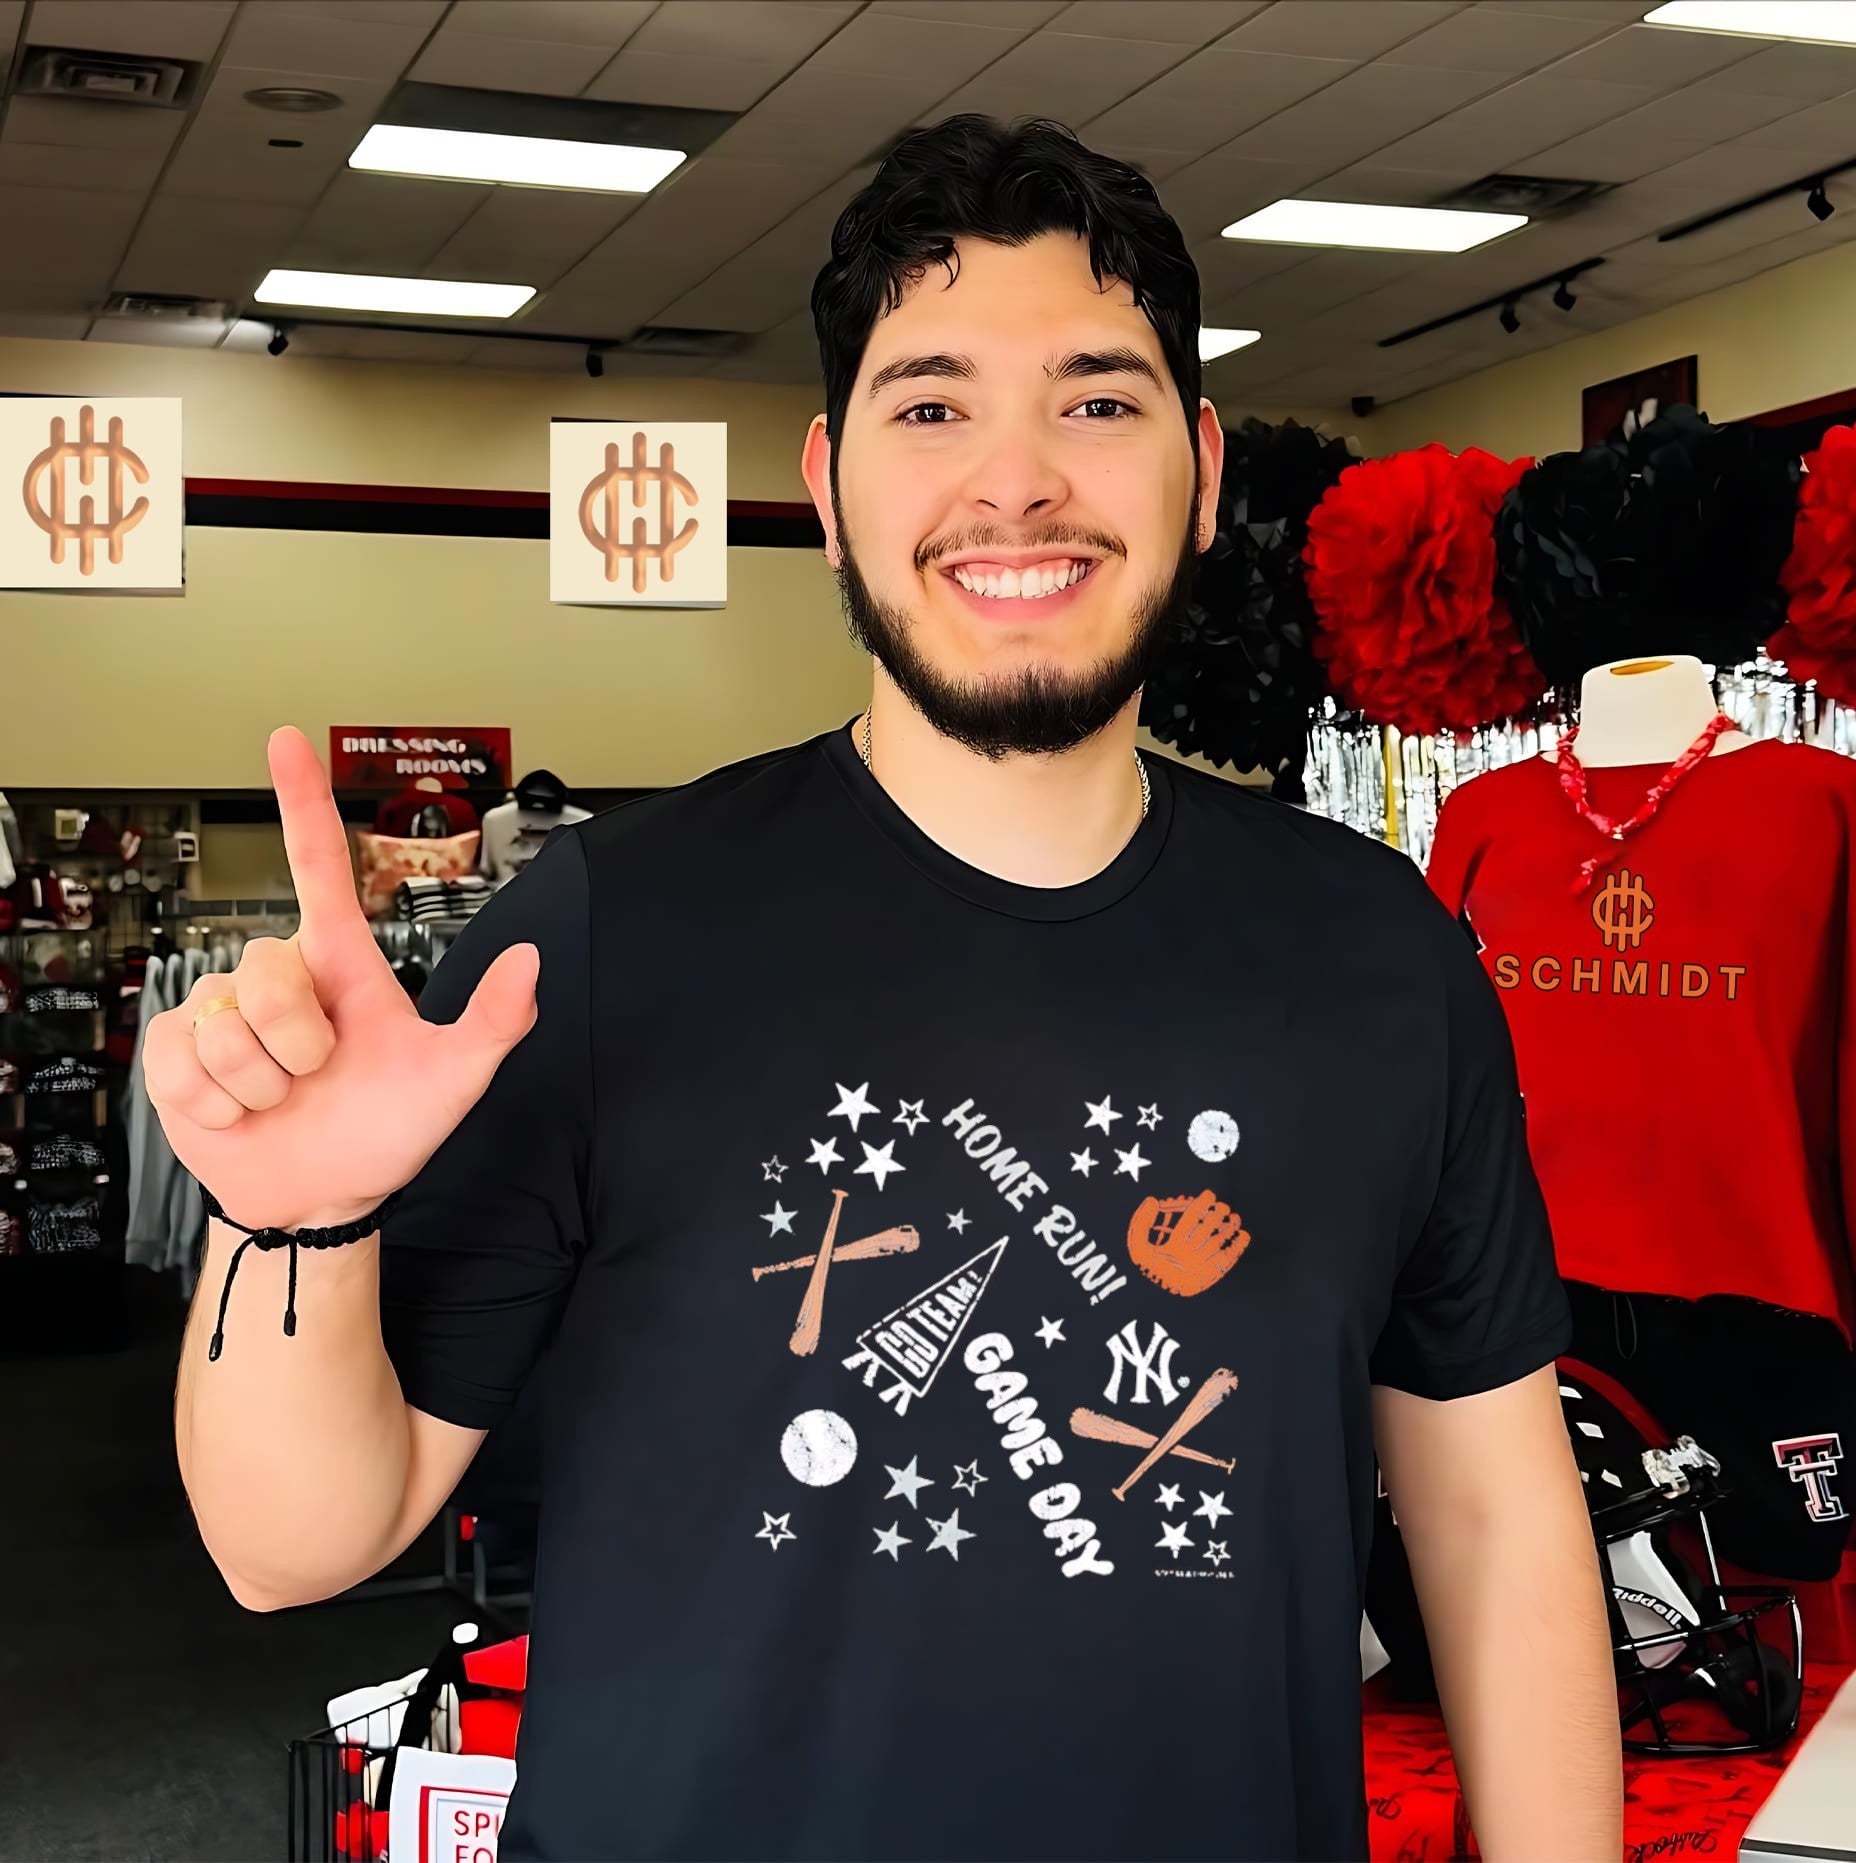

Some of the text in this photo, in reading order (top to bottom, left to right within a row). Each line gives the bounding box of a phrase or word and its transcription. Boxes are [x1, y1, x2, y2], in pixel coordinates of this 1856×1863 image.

[342, 737, 467, 754] DRESSING
[396, 758, 487, 775] ROOMS
[1494, 954, 1747, 1001] SCHMIDT
[942, 1098, 1127, 1306] HOME RUN!
[875, 1270, 983, 1379] GO TEAM!
[1103, 1319, 1181, 1406] NY
[963, 1332, 1115, 1578] GAME DAY
